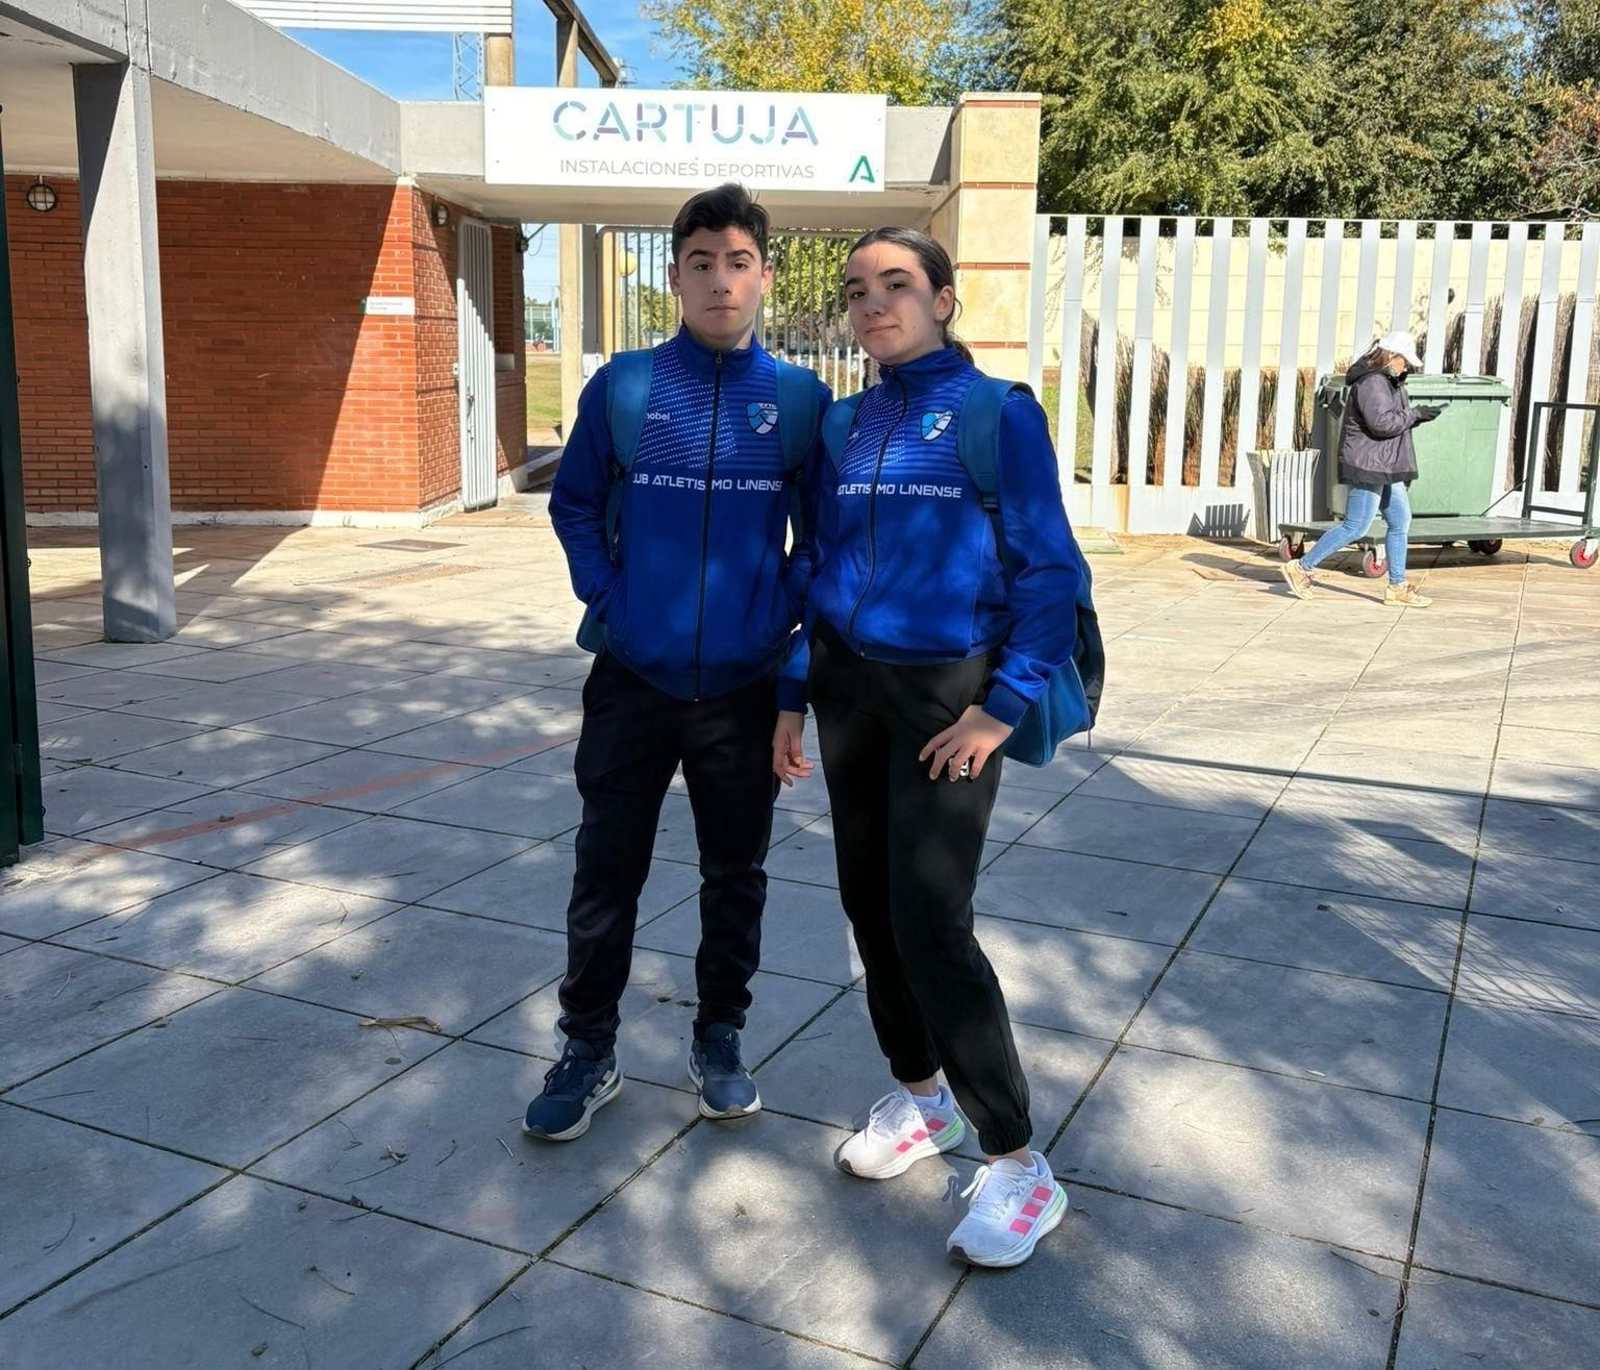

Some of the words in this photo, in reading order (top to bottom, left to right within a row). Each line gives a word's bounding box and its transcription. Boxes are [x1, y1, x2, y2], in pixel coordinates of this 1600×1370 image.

[553, 100, 818, 146] CARTUJA
[560, 159, 699, 176] INSTALACIONES
[703, 163, 815, 179] DEPORTIVAS
[632, 473, 649, 485] UB
[737, 479, 783, 491] LINENS
[899, 483, 962, 498] LINENSE
